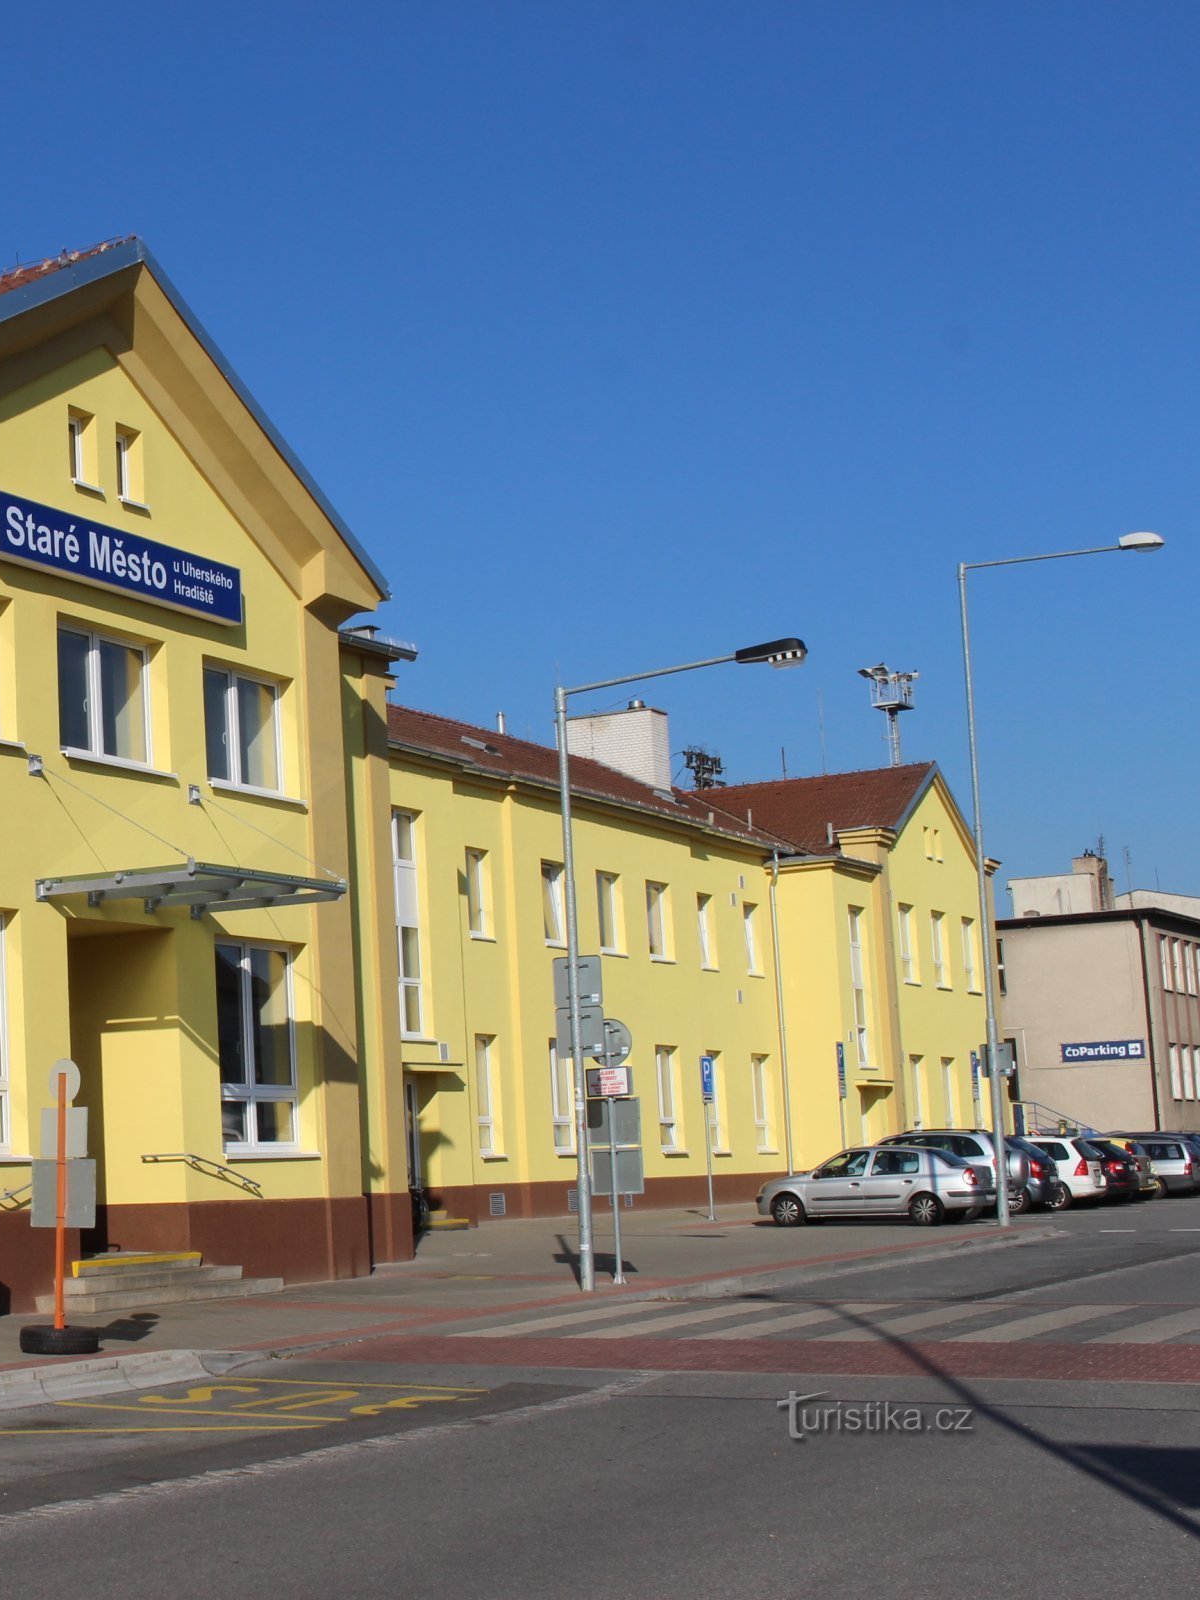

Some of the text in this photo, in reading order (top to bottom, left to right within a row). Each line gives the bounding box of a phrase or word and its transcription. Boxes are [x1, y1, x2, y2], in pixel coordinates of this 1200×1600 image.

[5, 505, 233, 590] Staré Město u Uherského
[173, 578, 214, 605] Hradiště
[702, 1060, 711, 1083] P
